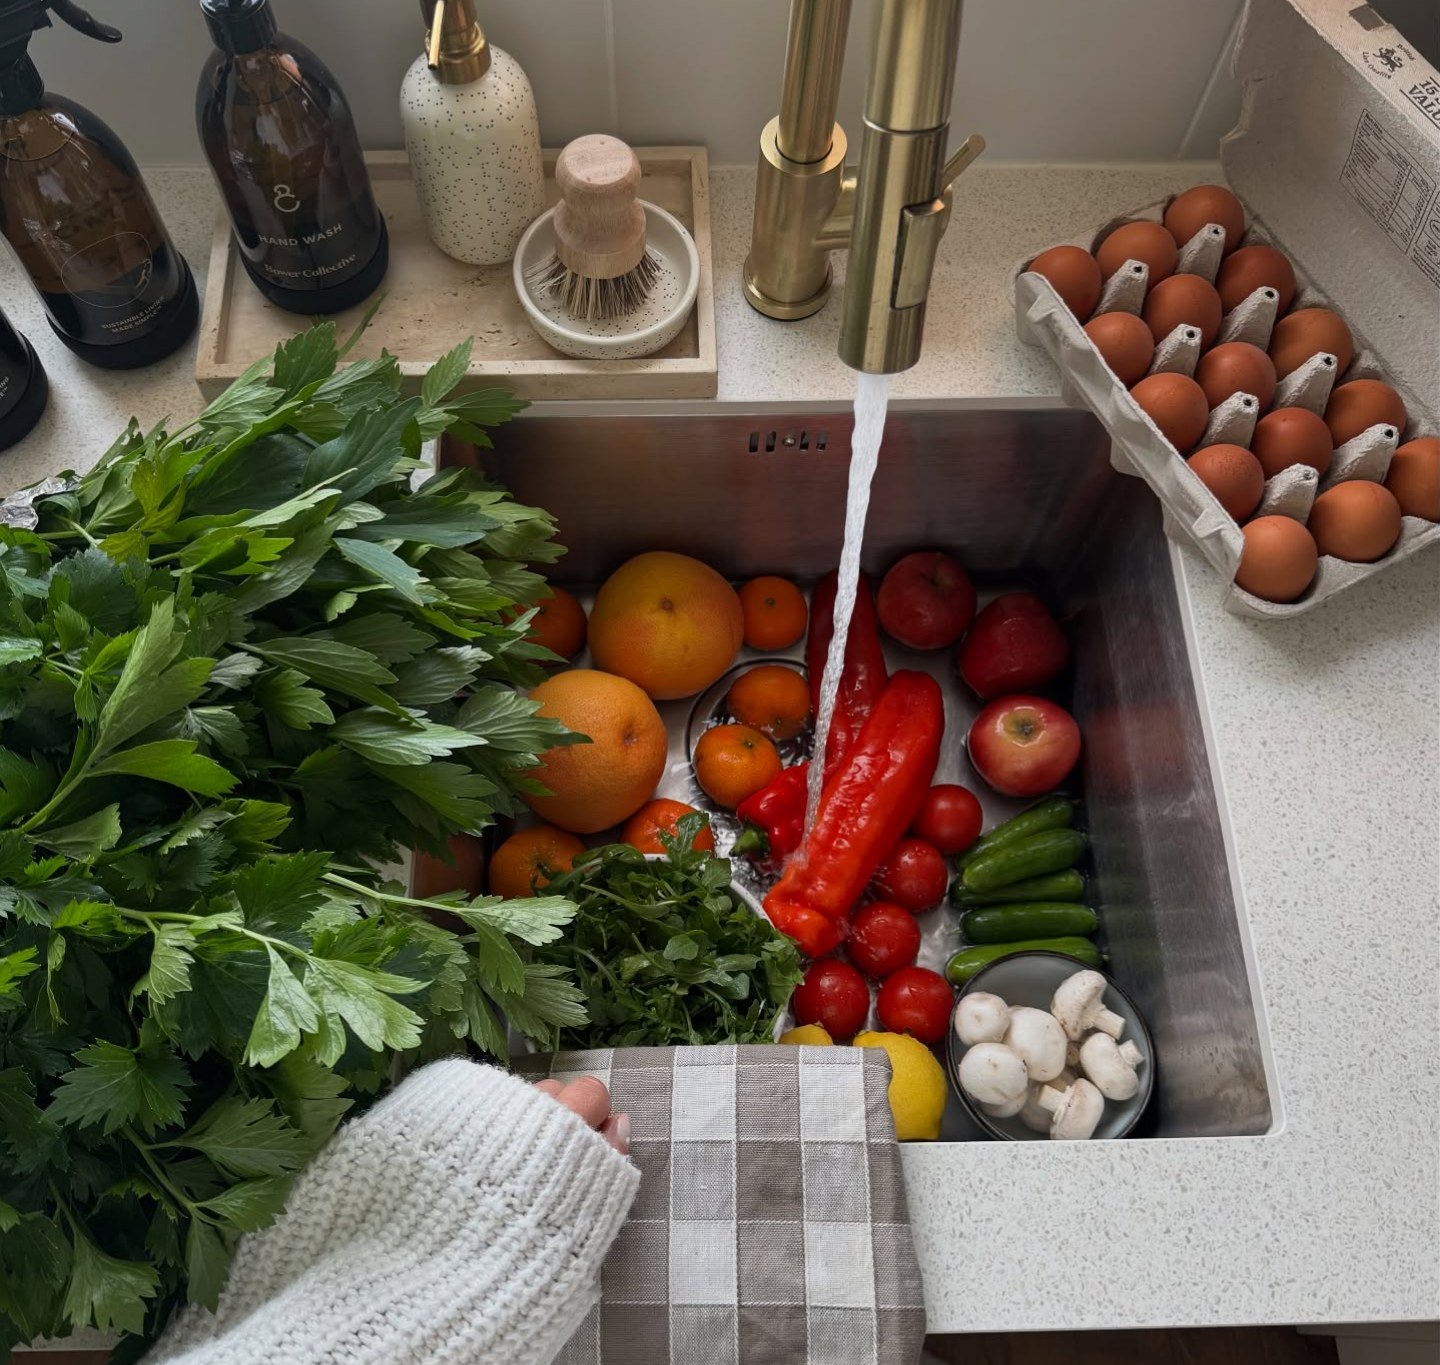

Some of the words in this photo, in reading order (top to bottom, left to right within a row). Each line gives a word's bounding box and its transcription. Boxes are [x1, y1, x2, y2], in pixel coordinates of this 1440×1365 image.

[258, 234, 298, 246] HAND
[302, 223, 343, 244] WASH
[264, 264, 301, 278] Bower
[303, 254, 356, 278] Collective
